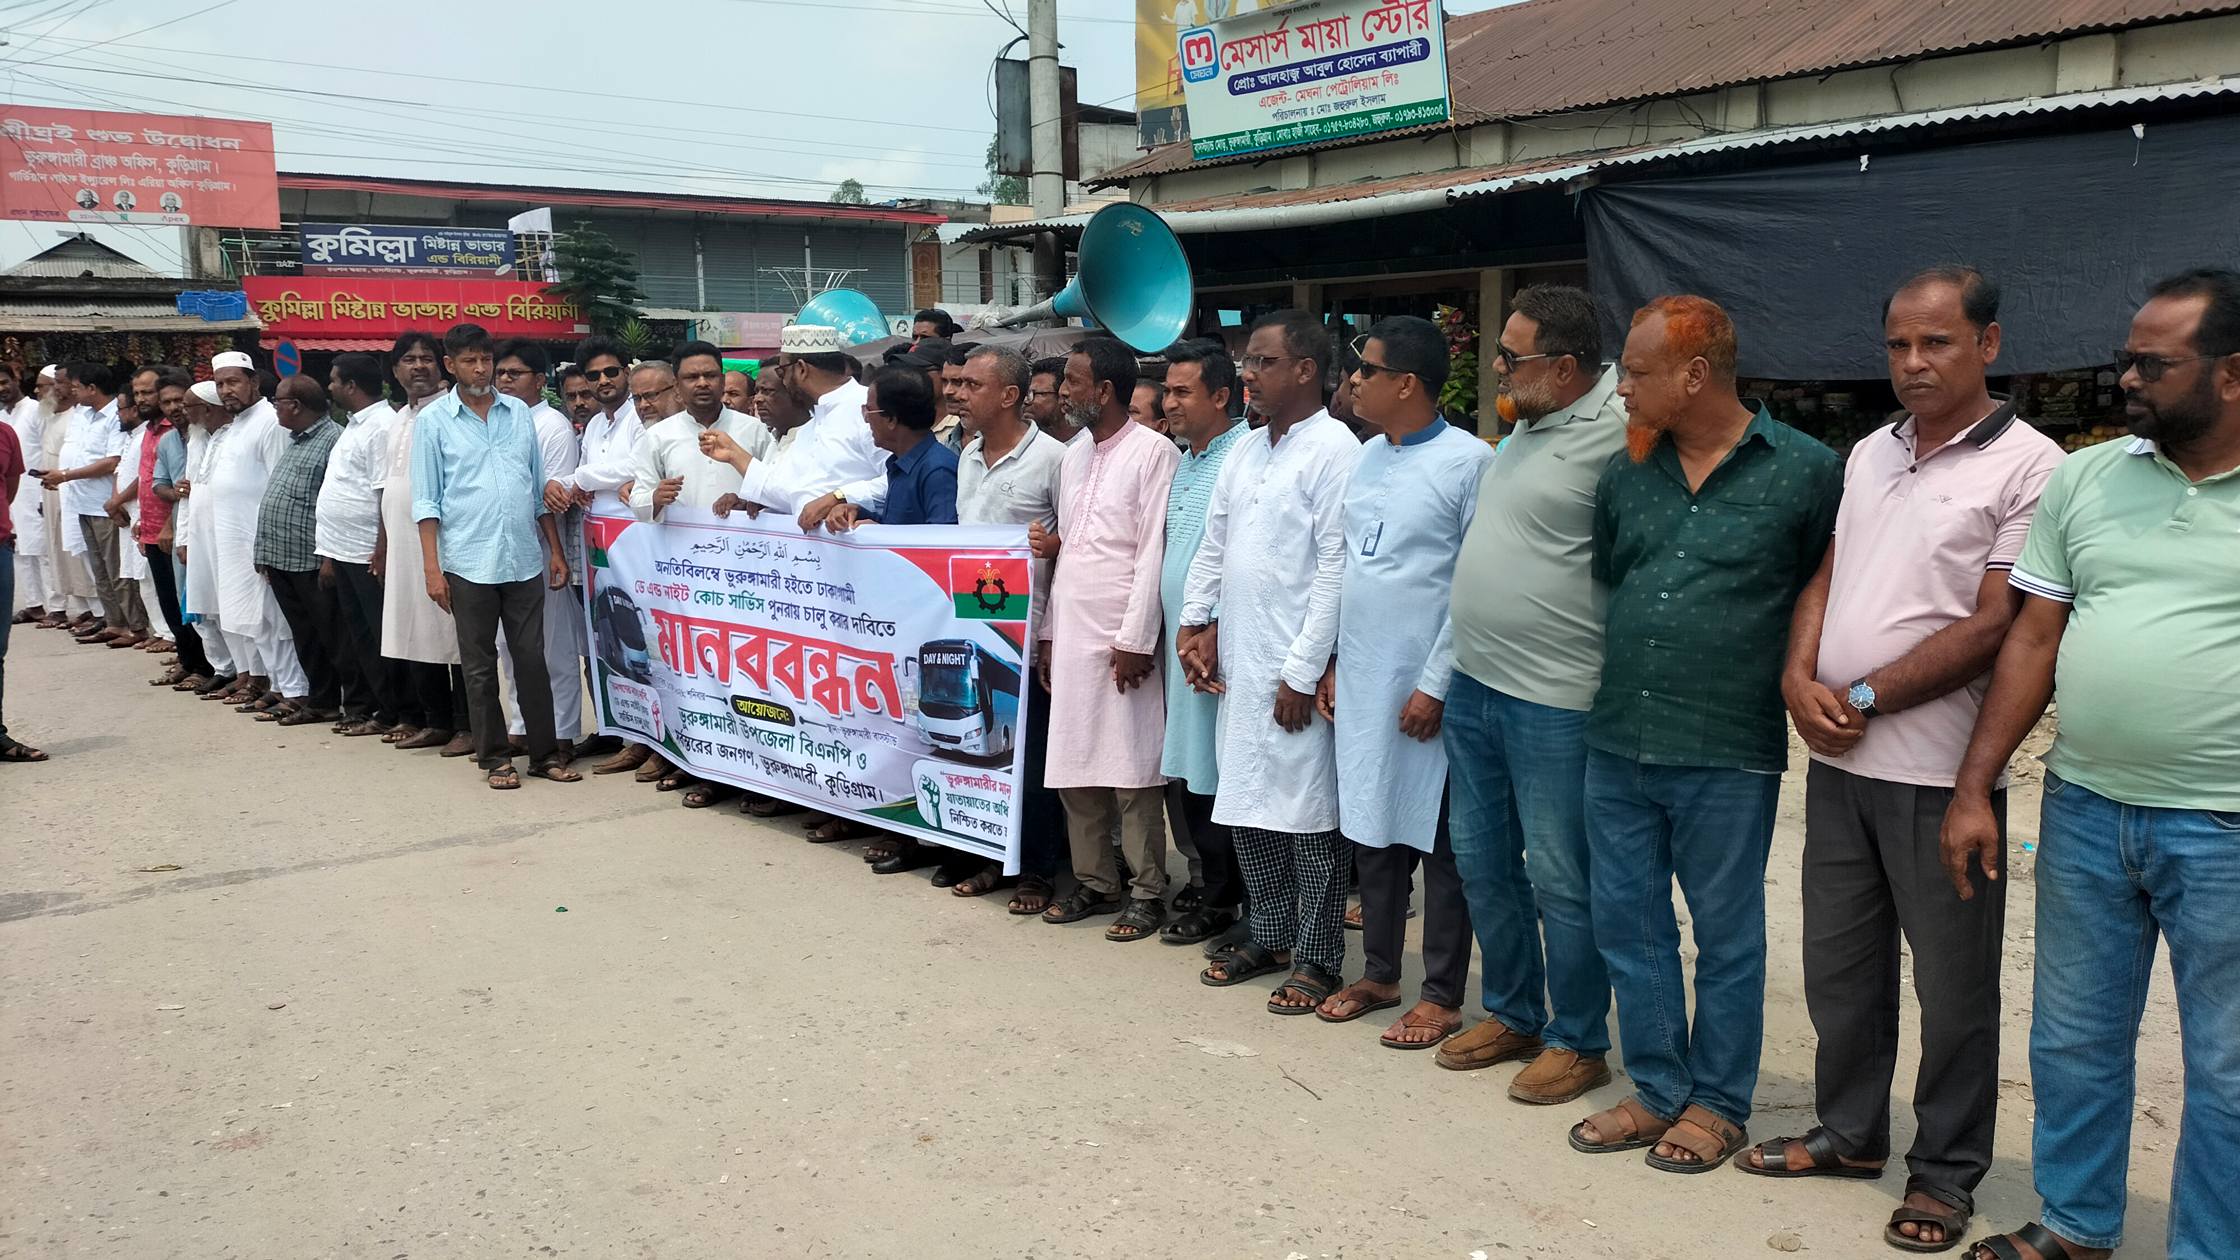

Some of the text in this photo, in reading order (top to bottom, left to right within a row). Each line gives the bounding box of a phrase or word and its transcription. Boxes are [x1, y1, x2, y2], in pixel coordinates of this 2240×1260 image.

[1220, 0, 1432, 71] মেসার্স মায়া স্টোর
[1302, 61, 1334, 77] আবুল
[1338, 52, 1377, 71] হোসেন
[1379, 40, 1422, 62] ব্যাপারী
[1295, 85, 1323, 103] মেঘনা
[1326, 76, 1379, 98] পেট্রোলিয়াম
[1360, 93, 1387, 106] ইসলাম
[161, 213, 184, 223] Apex
[305, 227, 418, 263] কুমিল্লা
[452, 252, 503, 266] বিরিয়ানী
[256, 290, 326, 323] কুমিল্লা
[329, 291, 388, 320] মিষ্টান্ন
[505, 294, 580, 322] বিরিয়ানী
[655, 557, 721, 582] অনতিবিলম্বে
[784, 573, 813, 595] হইতে
[635, 580, 646, 593] ডে
[663, 582, 690, 602] নাইট
[694, 589, 725, 607] কোচ
[728, 590, 765, 613] সার্ভিস
[768, 600, 801, 621] পুনরায়
[803, 605, 828, 631] চালু
[851, 612, 896, 637] দাবিতে
[650, 608, 904, 720] মানববন্ধন
[716, 743, 759, 770] জনগণ,
[739, 717, 795, 752] উপজেলা
[799, 730, 852, 767] বিএনপি
[856, 753, 867, 770] ও
[945, 792, 991, 812] যাতায়াতের
[980, 819, 1003, 837] করতে
